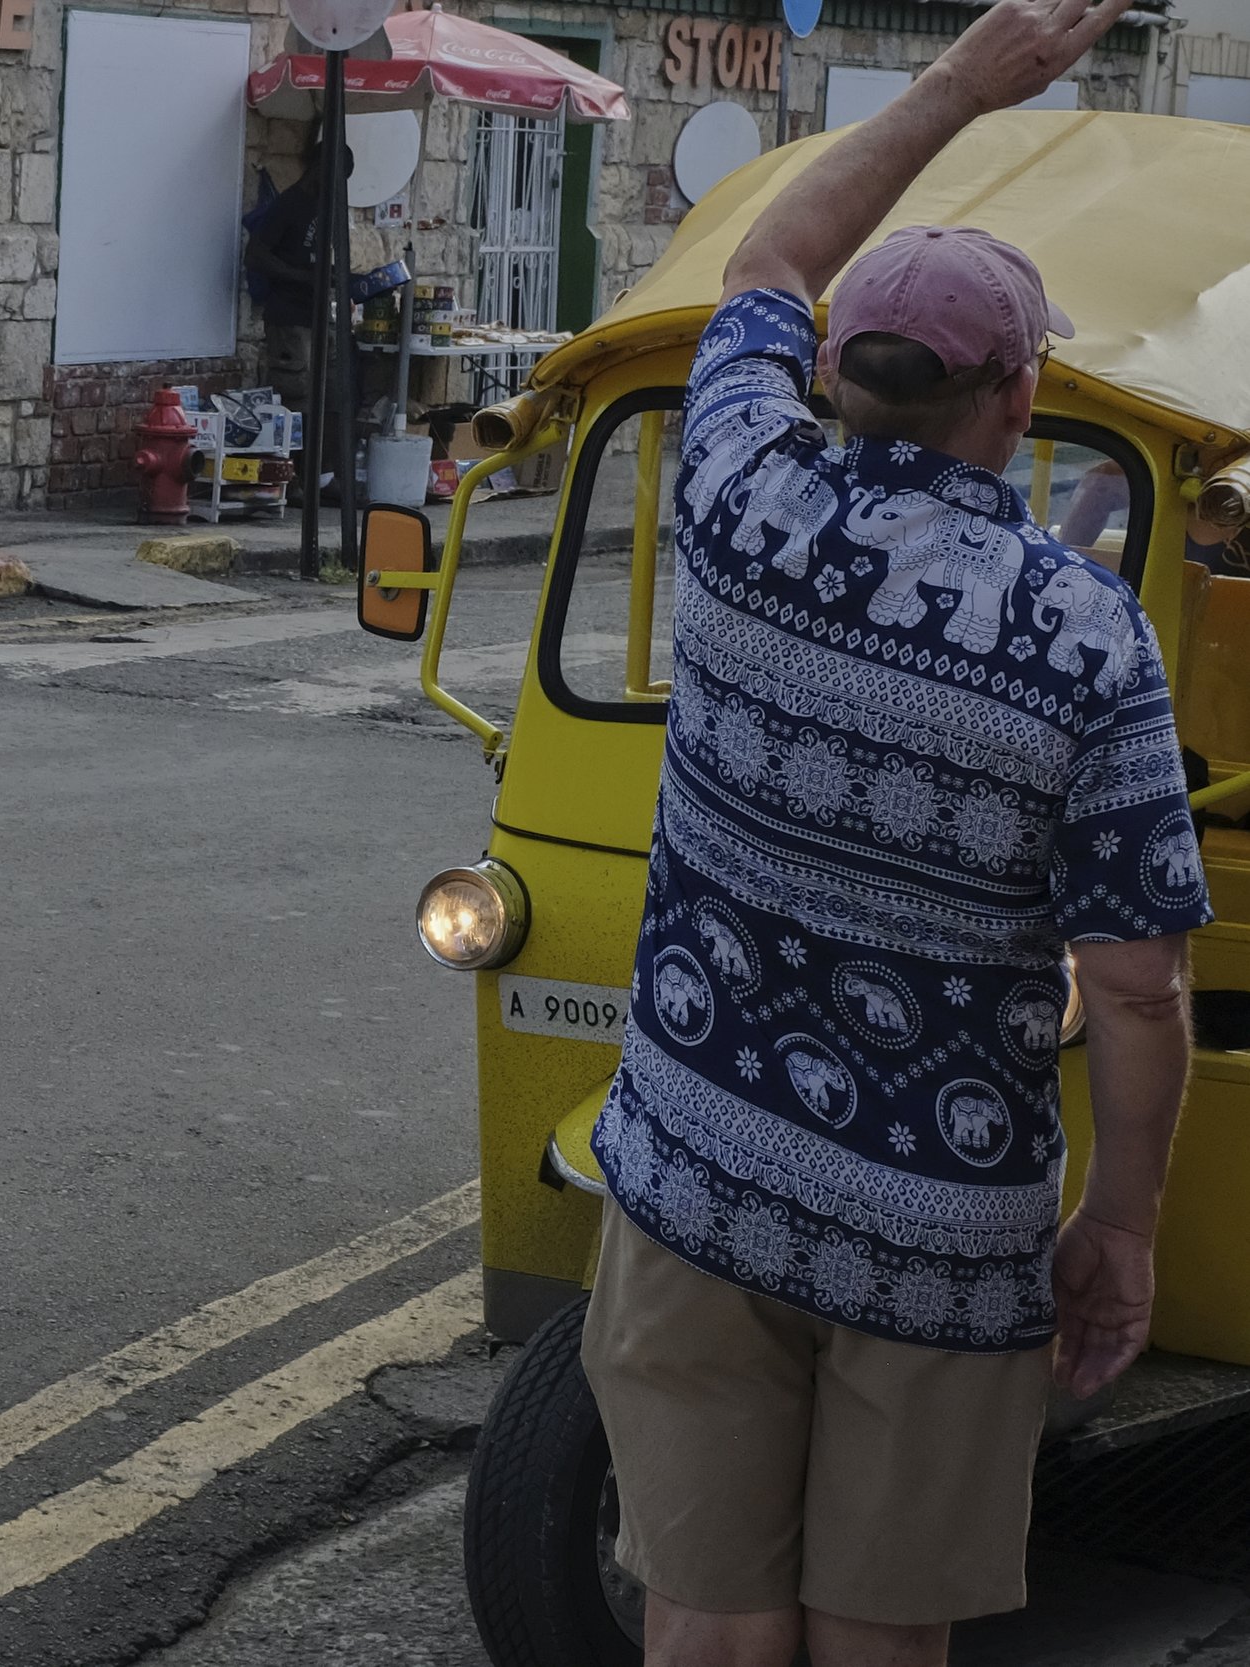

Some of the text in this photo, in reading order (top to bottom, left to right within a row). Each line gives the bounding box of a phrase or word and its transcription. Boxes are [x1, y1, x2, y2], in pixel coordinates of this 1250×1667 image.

[664, 15, 783, 91] STORE
[510, 991, 628, 1029] A 9009
